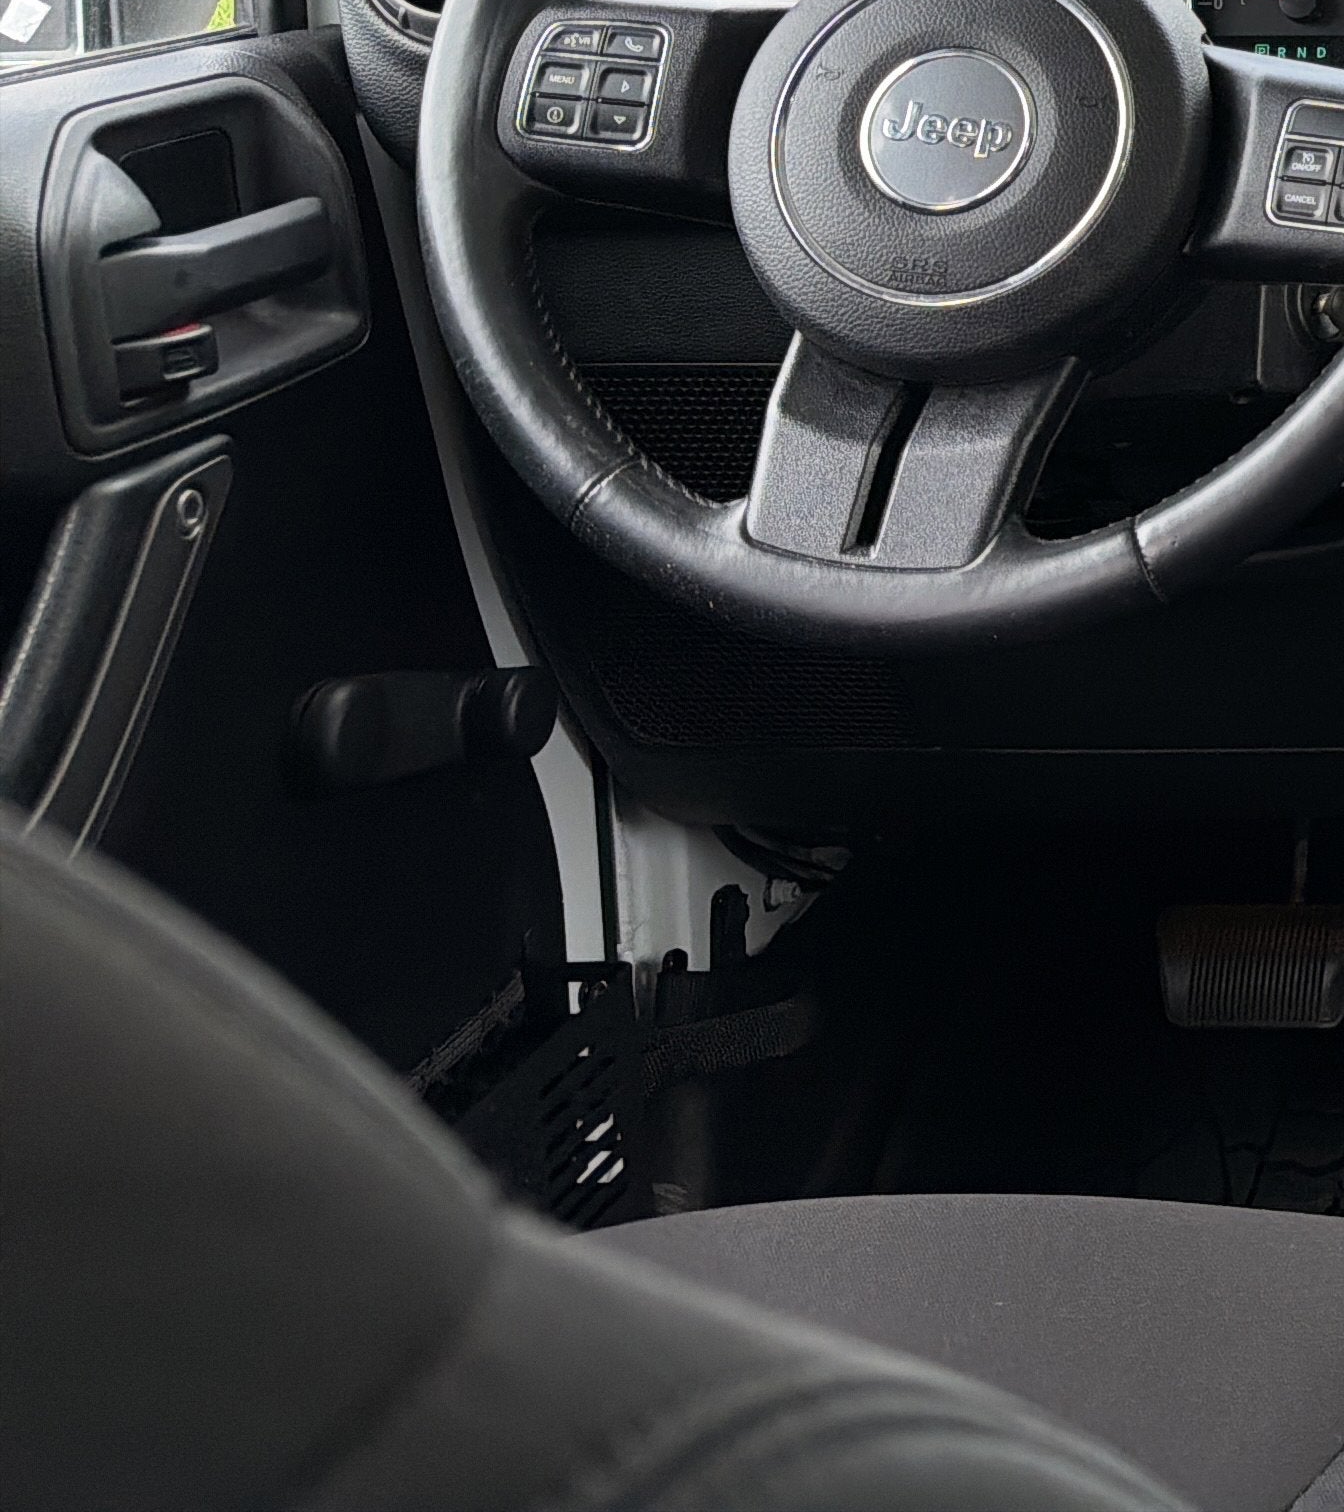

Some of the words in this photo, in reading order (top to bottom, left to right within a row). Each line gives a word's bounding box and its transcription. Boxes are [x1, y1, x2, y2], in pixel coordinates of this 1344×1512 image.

[1277, 46, 1287, 59] R
[1296, 46, 1307, 59] N
[1316, 46, 1327, 59] D
[548, 74, 576, 85] MENU
[882, 99, 1013, 159] Jeep
[1284, 193, 1317, 206] CANCEL
